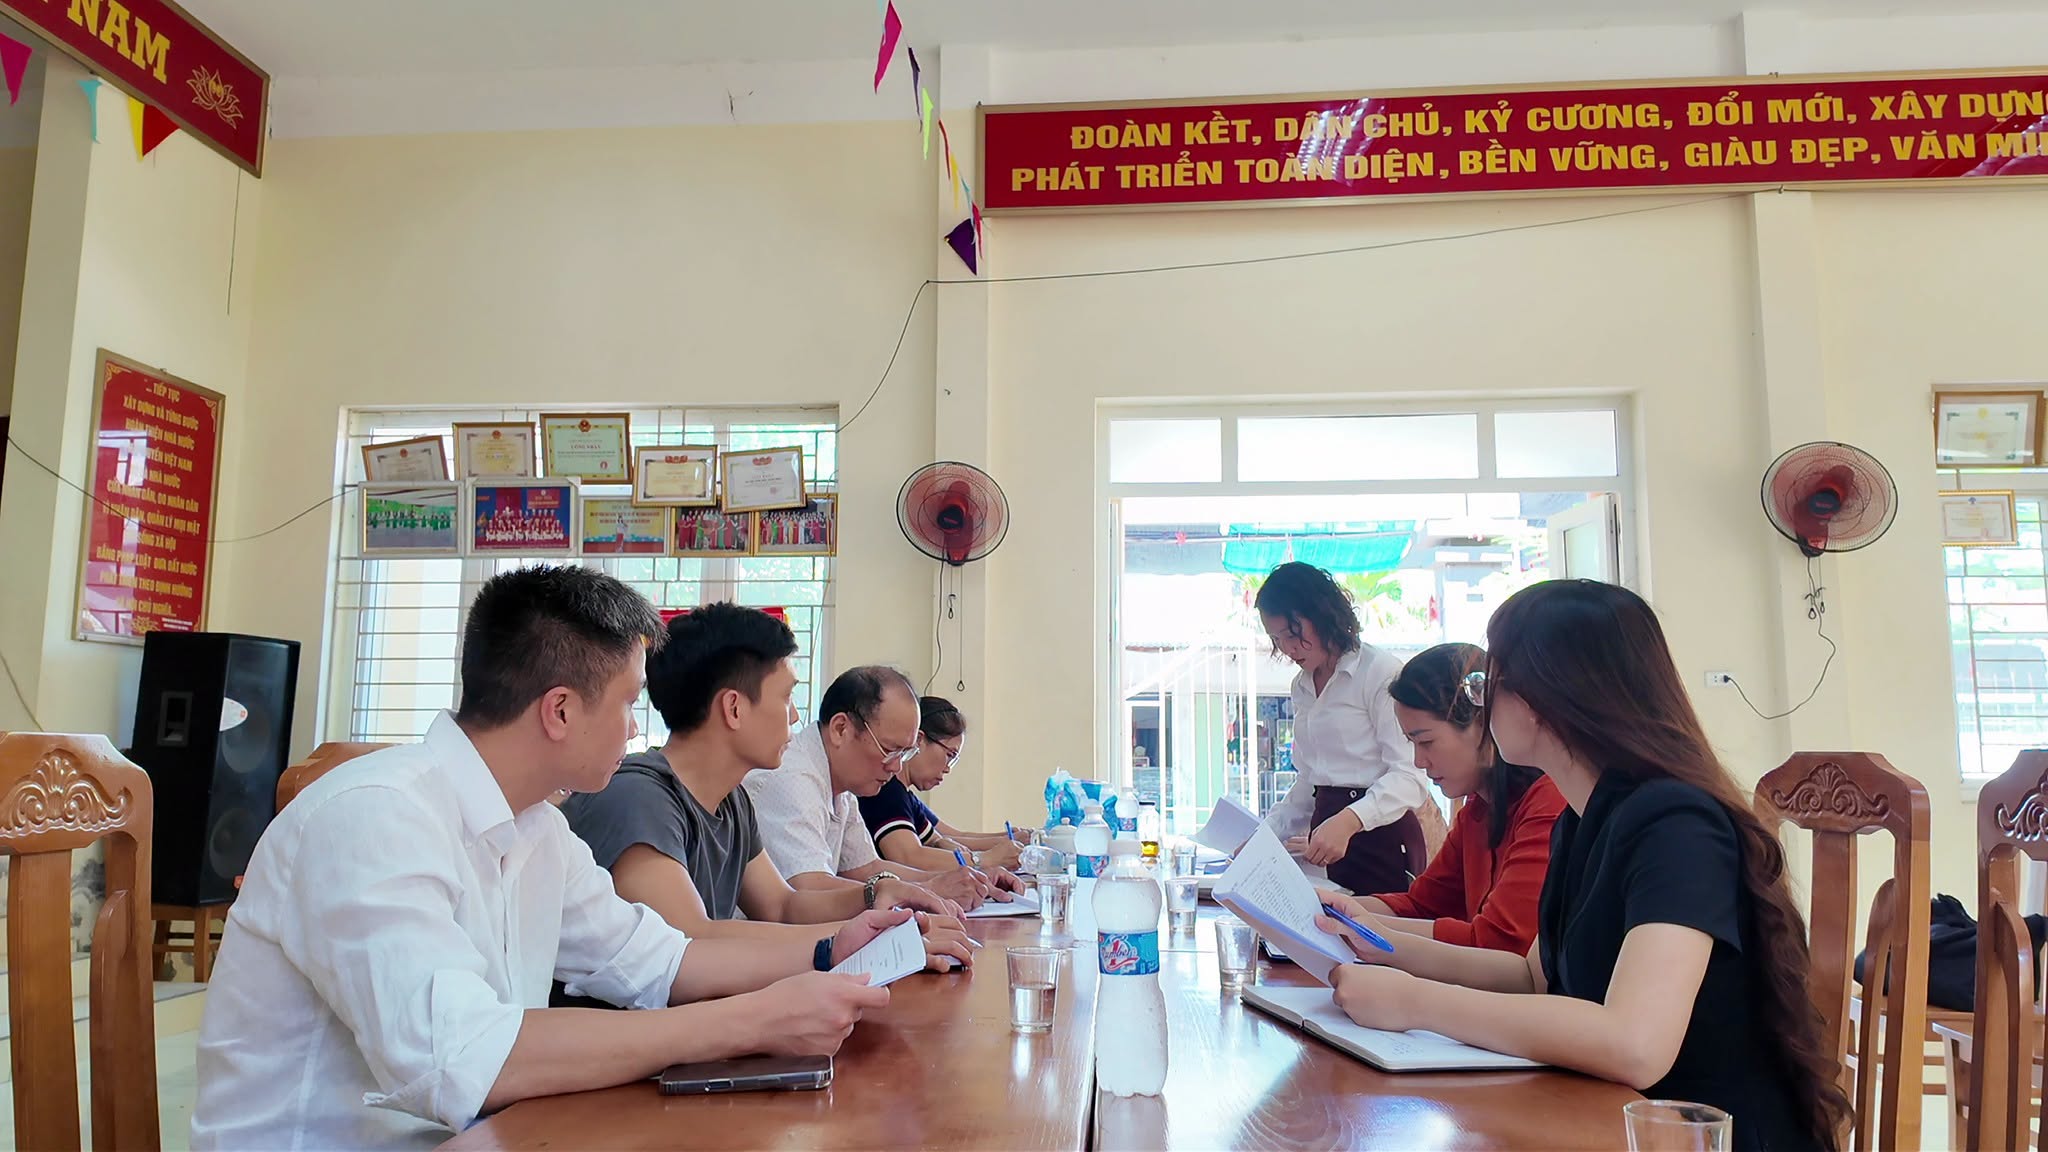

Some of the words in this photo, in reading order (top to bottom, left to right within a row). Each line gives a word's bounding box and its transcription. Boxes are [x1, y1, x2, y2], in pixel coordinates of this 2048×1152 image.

[67, 0, 170, 84] NAM
[1070, 116, 1171, 149] ĐOÀN
[1274, 111, 1352, 141] DÂN
[1363, 102, 1452, 137] CHỦ,
[1465, 100, 1514, 134] KỶ
[1526, 102, 1674, 133] CƯƠNG,
[1687, 90, 1754, 126] ĐỔI
[1767, 92, 1857, 125] MỚI,
[1870, 90, 1949, 121] XÂY
[1960, 89, 2048, 122] DỰN
[1011, 162, 1106, 192] PHÁT
[1115, 150, 1223, 190] TRIỂN
[1235, 152, 1333, 184] TOÀN
[1458, 139, 1537, 174] BỀN
[1548, 141, 1671, 172] VỮNG,
[1684, 136, 1777, 168] GIÀU
[1789, 137, 1882, 169] ĐẸP,
[1890, 131, 1976, 161] VĂN
[164, 452, 177, 468] VIỆT
[178, 458, 192, 472] NAM
